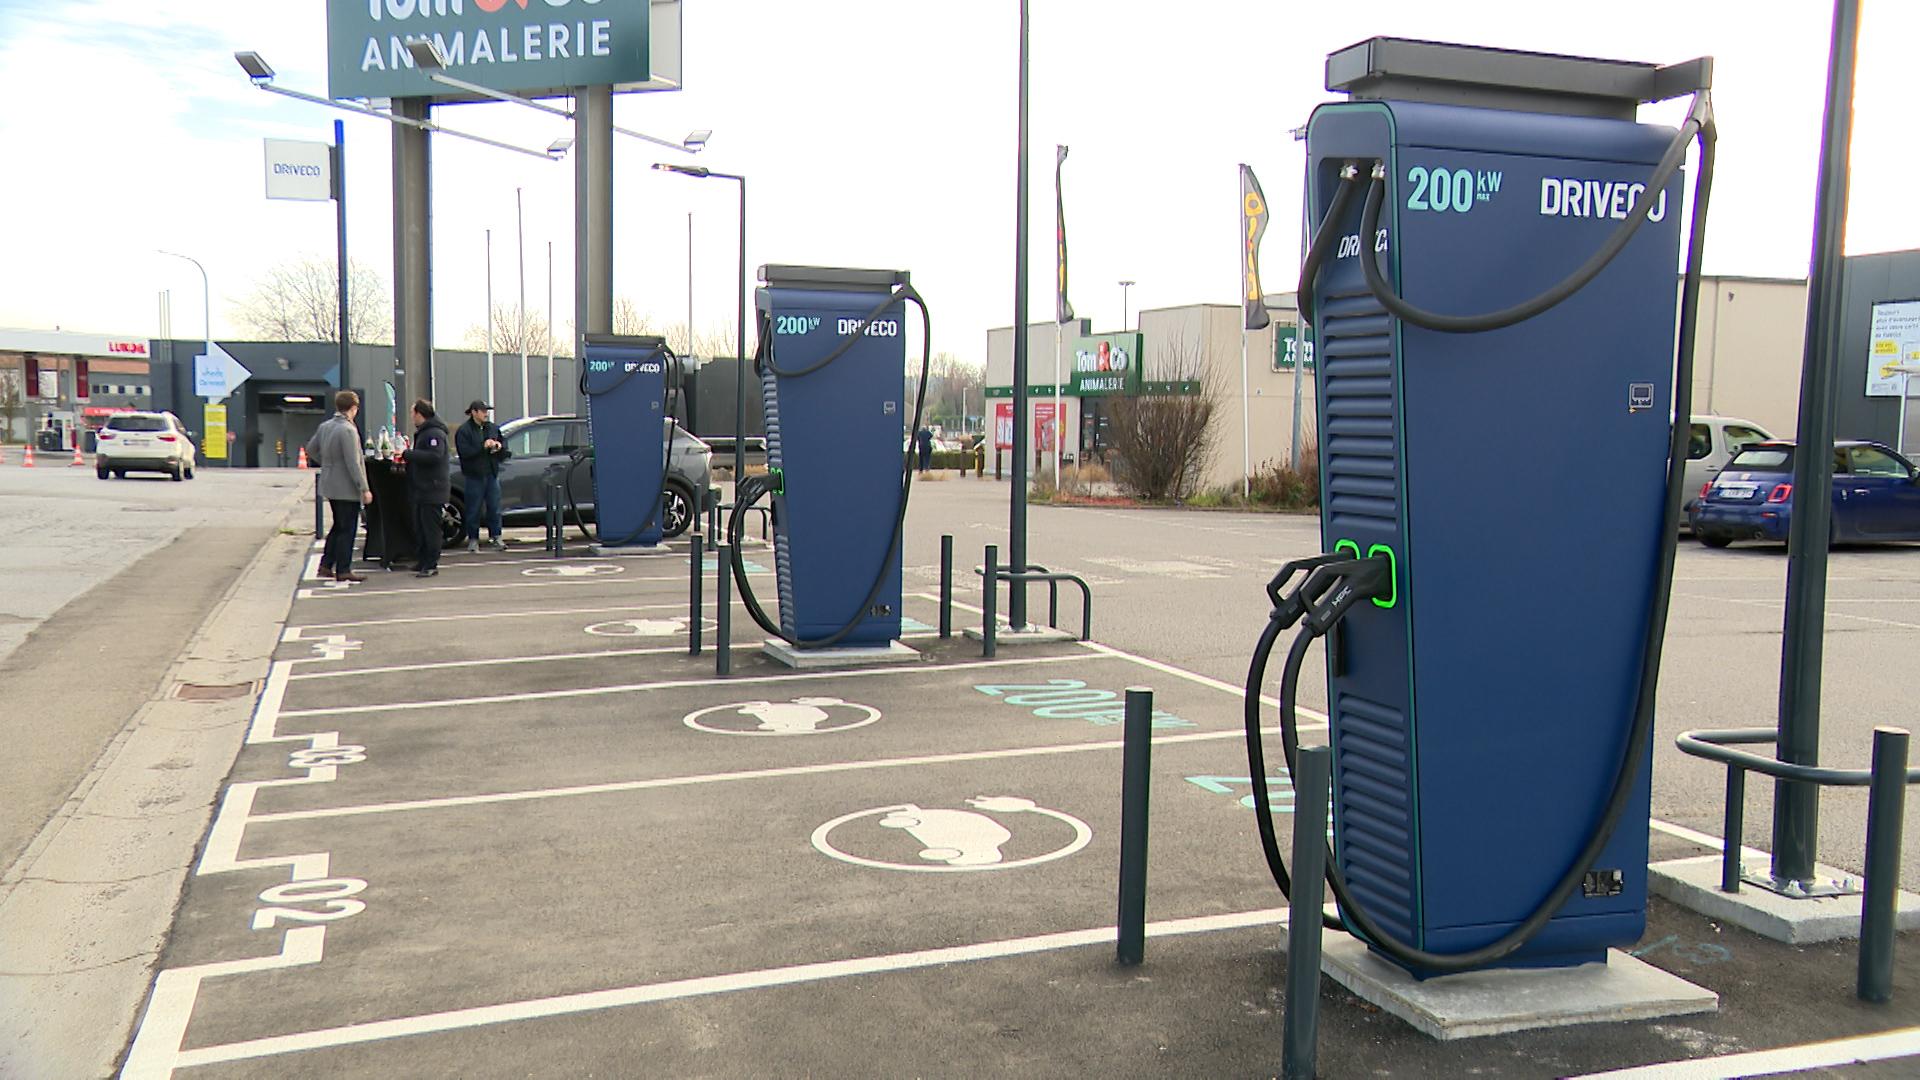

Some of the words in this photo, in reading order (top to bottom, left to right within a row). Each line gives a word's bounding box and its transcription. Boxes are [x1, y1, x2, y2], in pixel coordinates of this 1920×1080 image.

[361, 19, 610, 71] ANMALERIE
[273, 163, 321, 176] DRIVECO
[1407, 166, 1474, 213] 200
[1476, 170, 1503, 192] kW
[777, 315, 808, 335] 200
[589, 361, 608, 372] 200
[1080, 377, 1125, 392] ANIMALERIE
[288, 744, 368, 768] 03
[251, 878, 368, 930] 02
